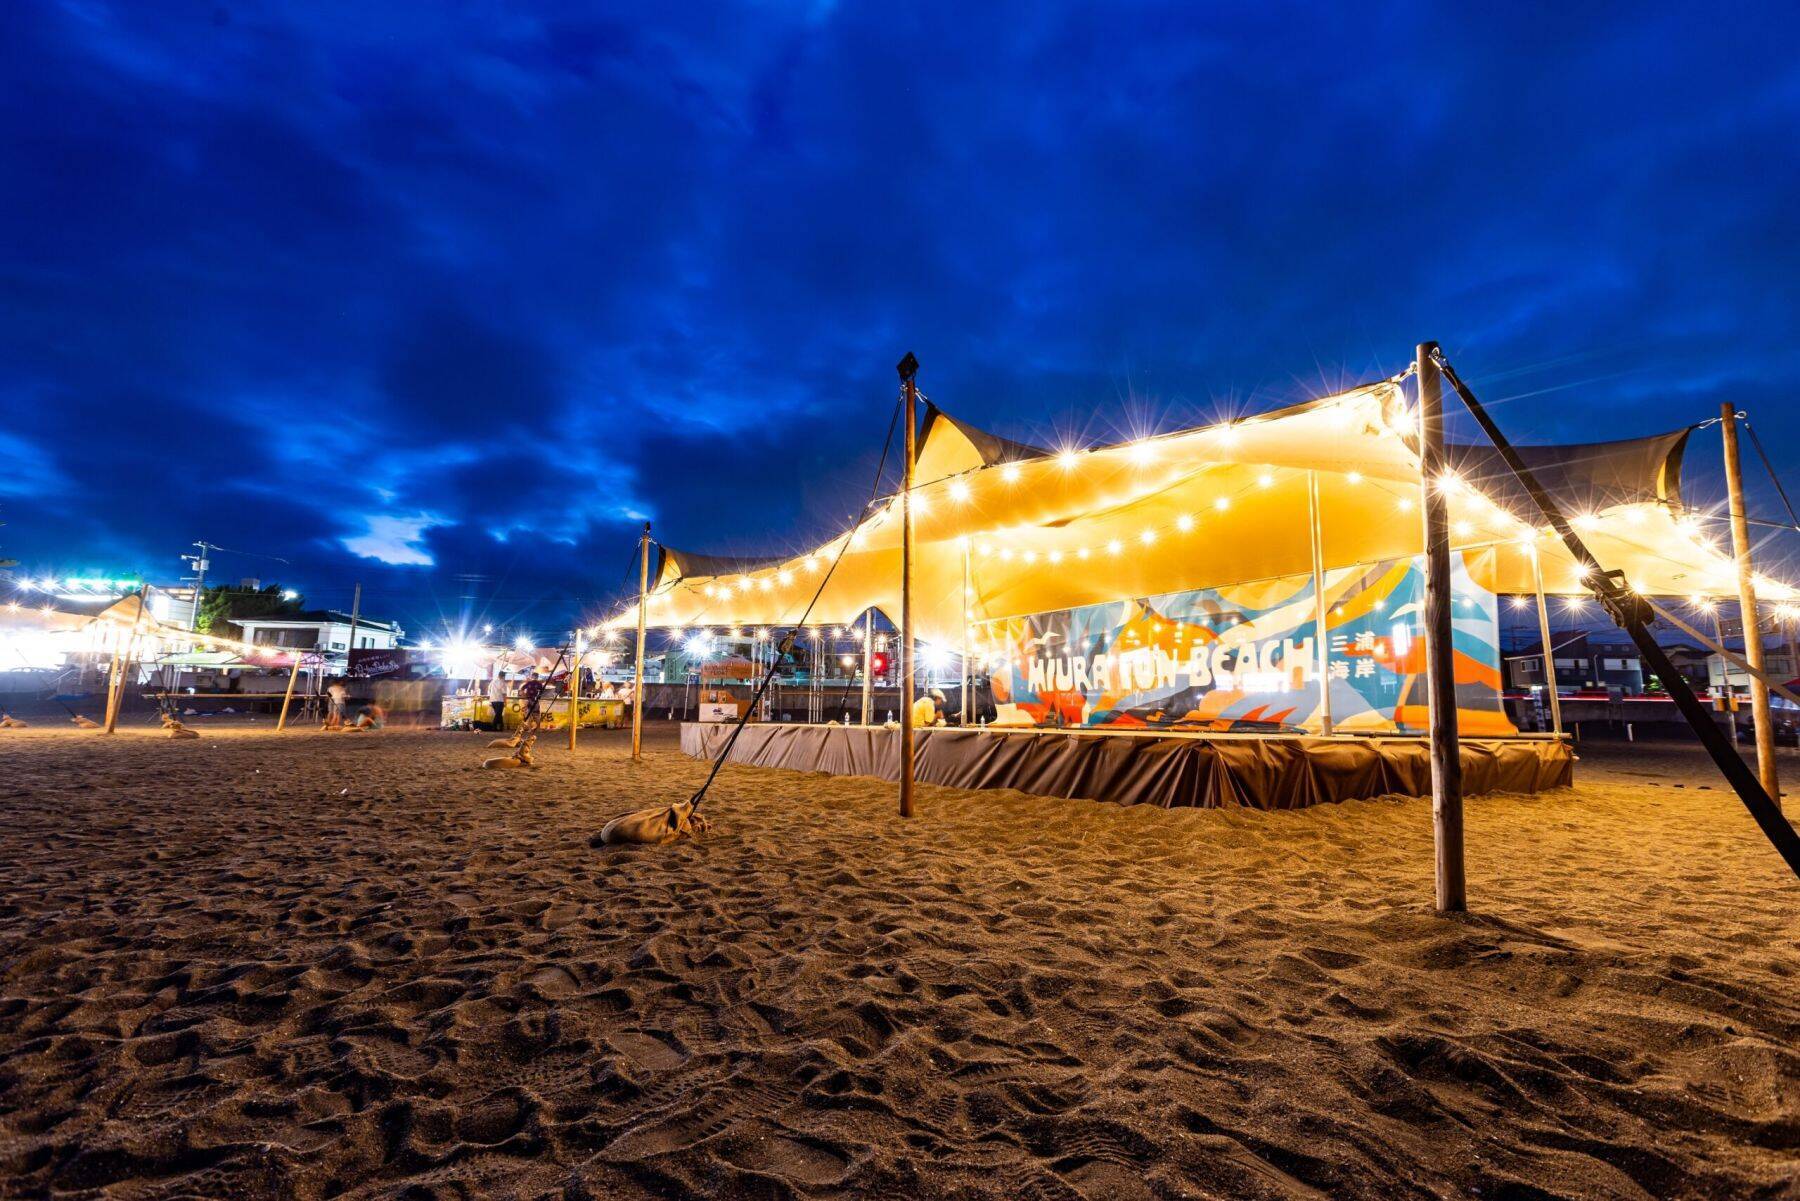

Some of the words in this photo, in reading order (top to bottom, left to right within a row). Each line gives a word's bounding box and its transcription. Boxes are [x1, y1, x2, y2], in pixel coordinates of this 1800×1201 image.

[1330, 630, 1376, 652] 三浦
[1028, 655, 1112, 692] MIURA
[1190, 637, 1314, 687] BEACH
[1328, 658, 1376, 679] 海岸
